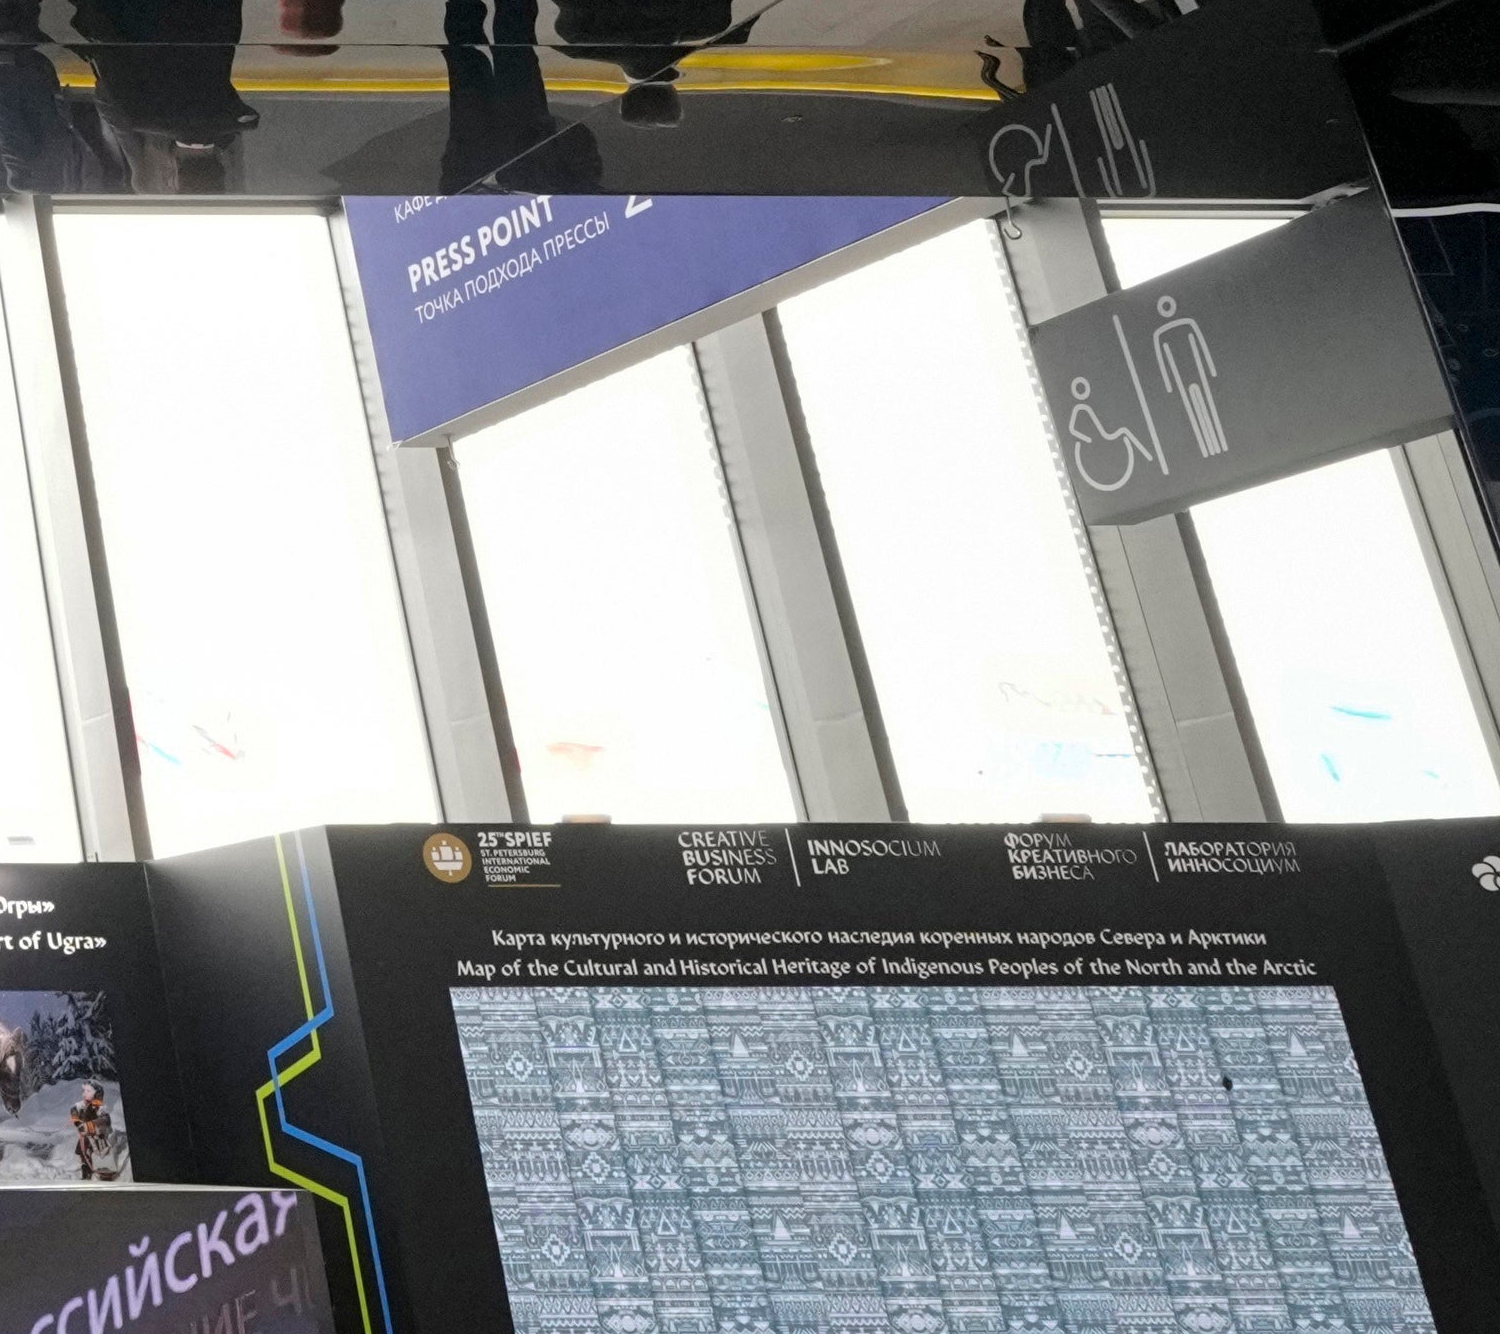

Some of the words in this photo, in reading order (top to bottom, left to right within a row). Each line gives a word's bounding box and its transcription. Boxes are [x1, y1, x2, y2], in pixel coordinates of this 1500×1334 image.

[408, 235, 475, 292] PRESS
[478, 195, 554, 256] POINT
[415, 286, 463, 324] ТОЧКА
[465, 253, 542, 301] ПОДХОДА
[544, 211, 610, 262] ПРЕССЫ
[678, 831, 770, 848] CREATIVE
[1004, 832, 1071, 849] ФОРУМ
[682, 848, 777, 866] BUSINESS
[808, 839, 941, 858] INNOSOCIUM
[1008, 847, 1137, 864] КРЕАТИВНОГО
[1164, 840, 1296, 857] ЛАБОРАТОРИЯ
[481, 857, 550, 866] INTERNATIONAL
[483, 865, 530, 874] ECONOMIC
[812, 858, 850, 875] LAB
[1168, 857, 1300, 873] ИННОСОЦИУМ
[485, 874, 516, 883] FORUM
[687, 867, 762, 885] FORUM
[1012, 865, 1094, 880] БИЗНЕСА
[18, 930, 41, 951] of
[47, 931, 107, 955] Ugra»
[492, 930, 546, 949] Карта
[551, 930, 664, 949] культурного
[669, 933, 681, 944] и
[685, 930, 822, 949] исторического
[828, 930, 915, 948] наследия
[920, 931, 1012, 945] коренных
[1017, 931, 1095, 947] народов
[1100, 929, 1165, 947] Севера
[1169, 933, 1183, 944] и
[1188, 929, 1267, 947] Арктики
[457, 961, 496, 980] Map
[501, 961, 525, 976] of
[528, 961, 559, 976] the
[564, 960, 638, 976] Cultural
[643, 960, 677, 976] and
[680, 960, 769, 976] Historical
[773, 959, 851, 980] Heritage
[855, 959, 878, 975] of
[881, 958, 984, 978] Indigenous
[988, 958, 1058, 978] Peoples
[1063, 958, 1086, 975] of
[1089, 958, 1120, 975] the
[1126, 958, 1183, 975] North
[1188, 958, 1222, 975] and
[1227, 958, 1258, 975] the
[1262, 958, 1317, 975] Arctic
